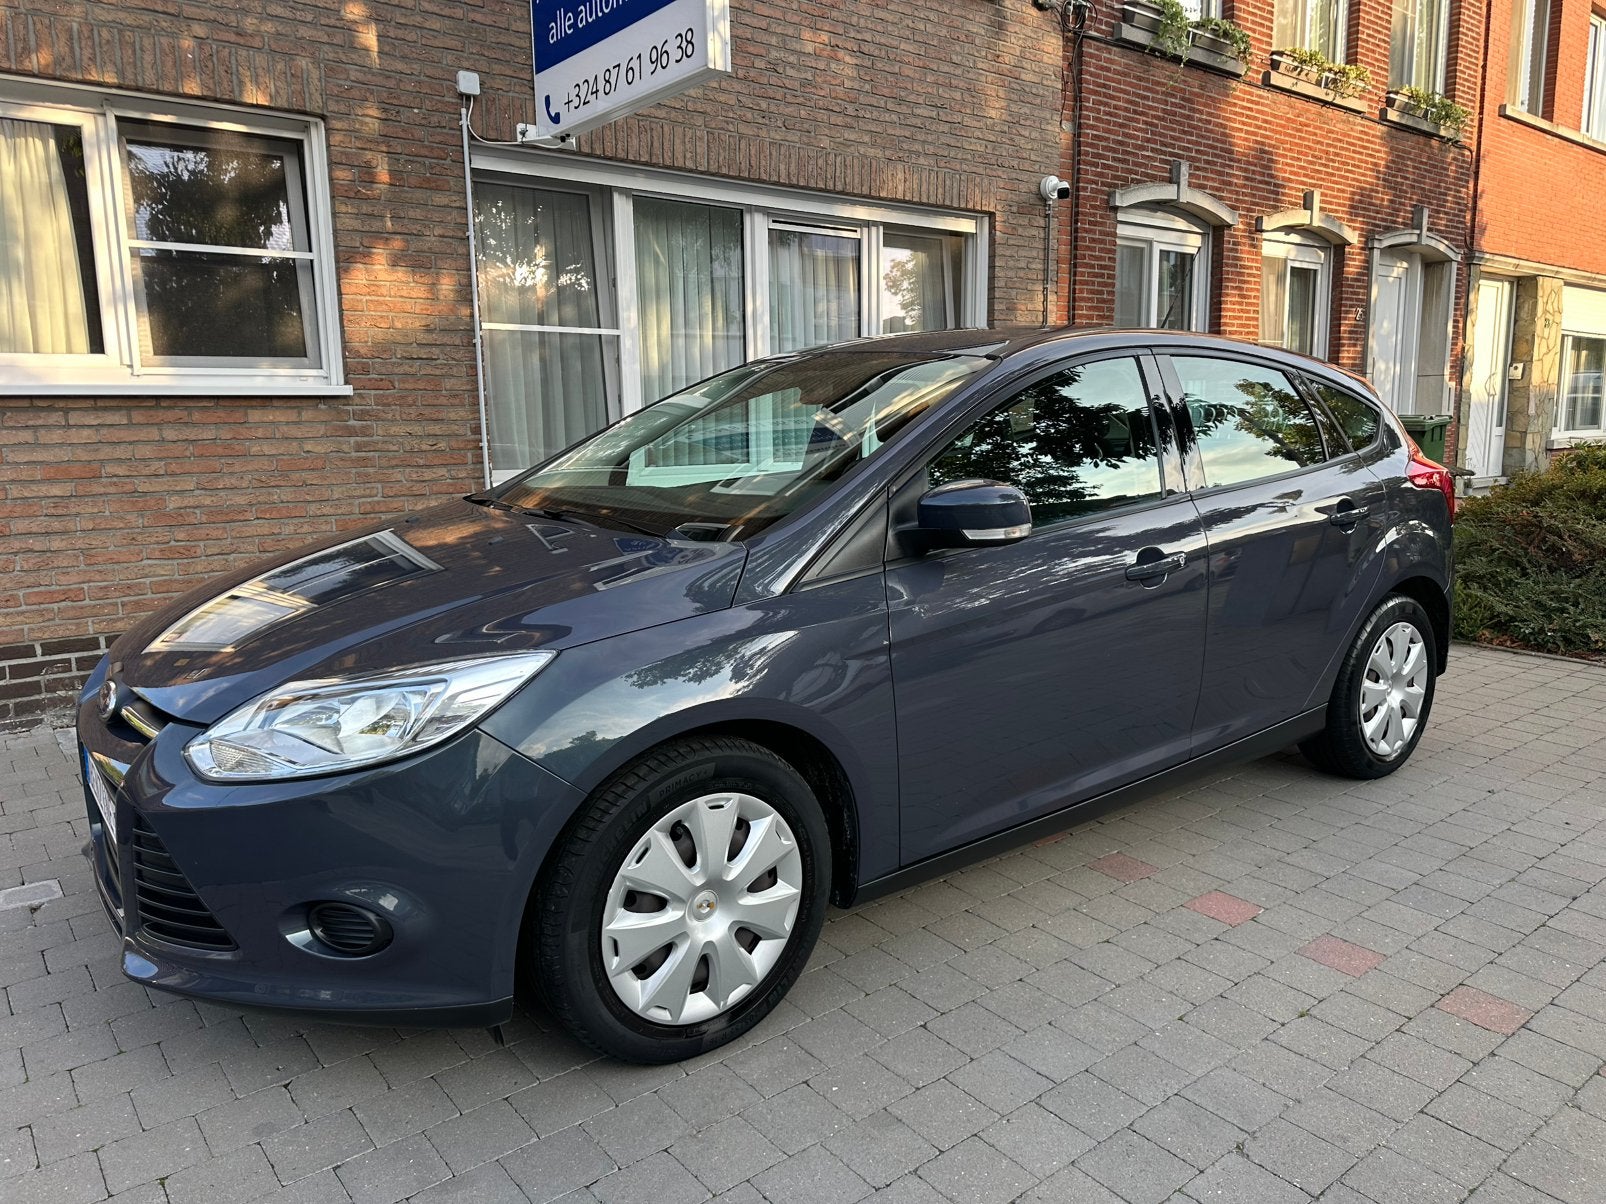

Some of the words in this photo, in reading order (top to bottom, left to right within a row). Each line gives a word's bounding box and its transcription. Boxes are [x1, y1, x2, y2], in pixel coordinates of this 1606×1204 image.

[549, 7, 574, 44] alle
[564, 74, 600, 113] +324
[602, 63, 621, 96] 87
[625, 53, 642, 86] 61
[649, 39, 670, 76] 96
[674, 27, 695, 63] 38
